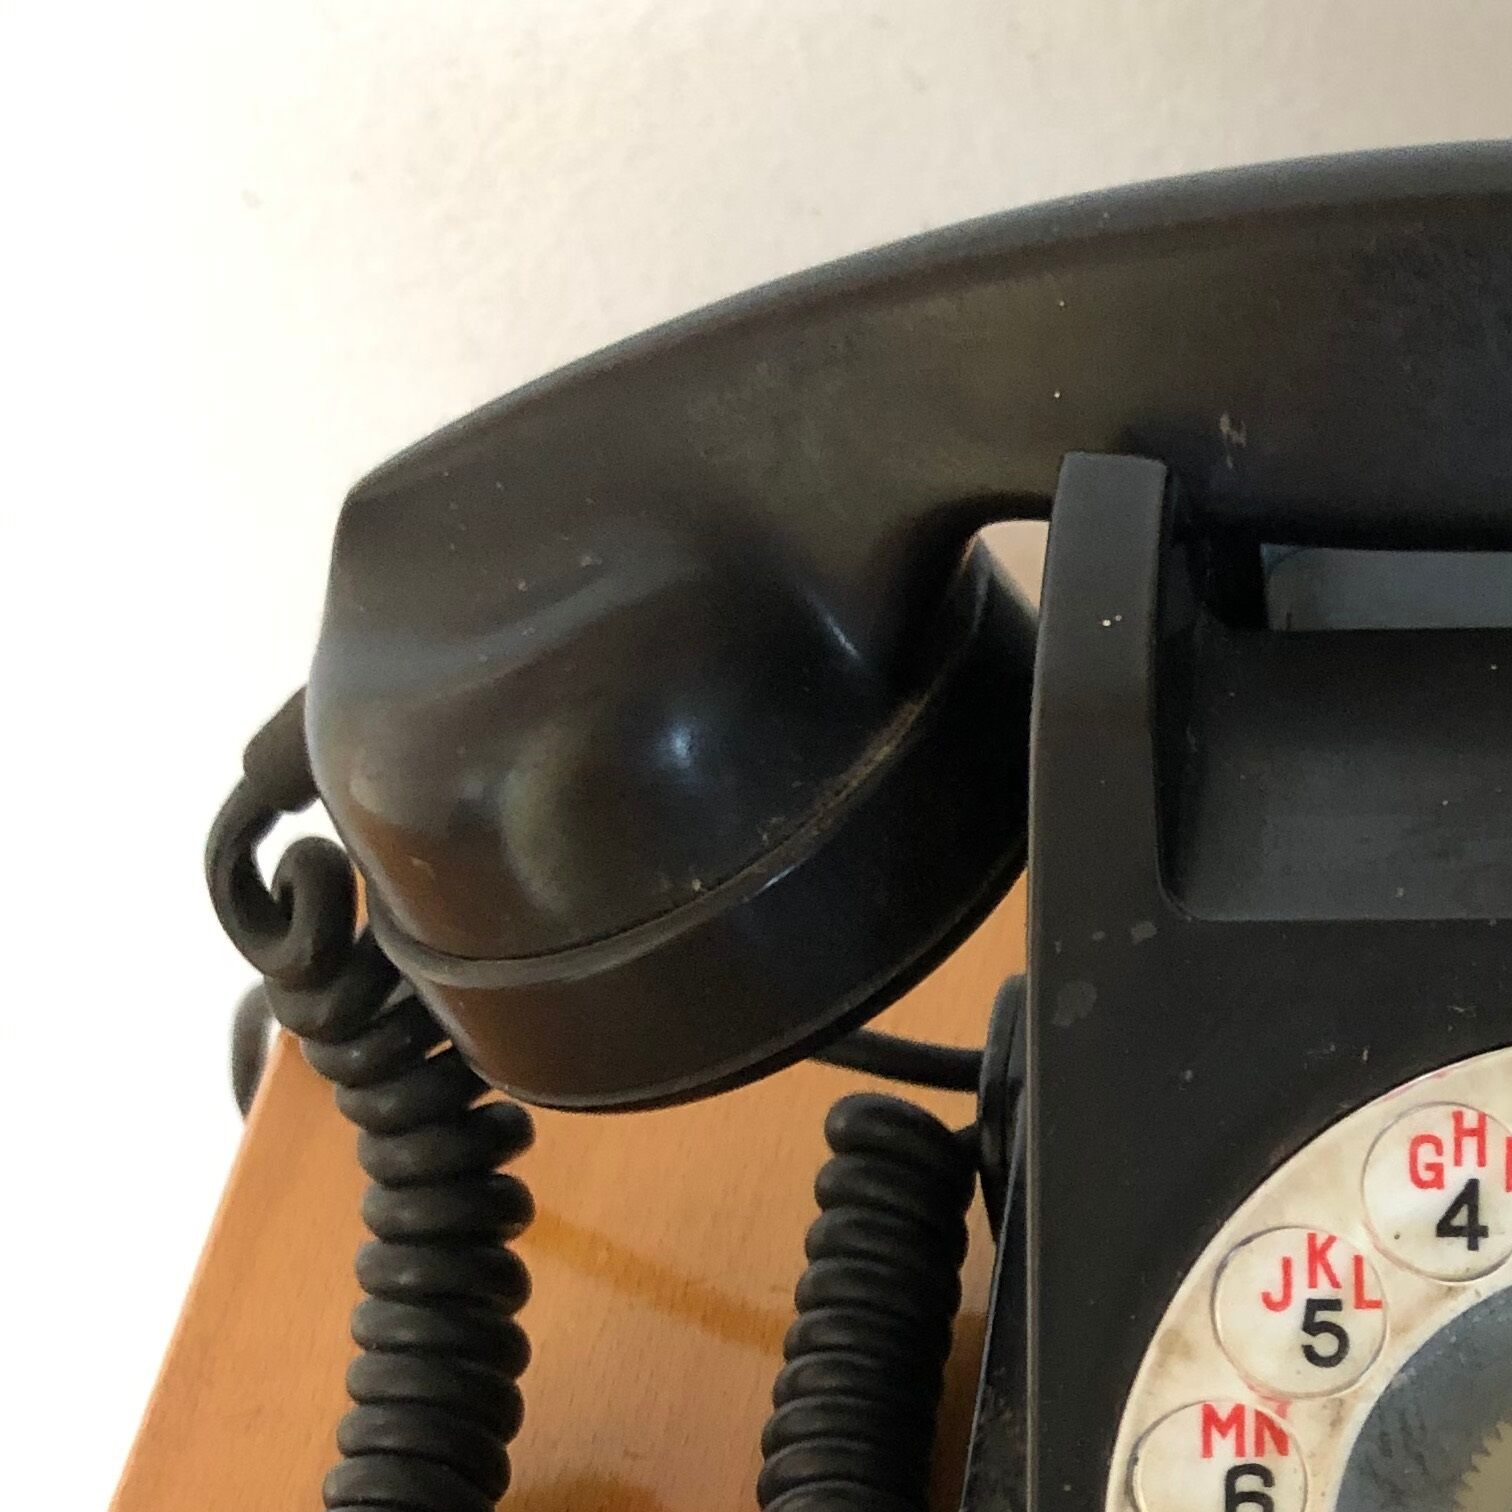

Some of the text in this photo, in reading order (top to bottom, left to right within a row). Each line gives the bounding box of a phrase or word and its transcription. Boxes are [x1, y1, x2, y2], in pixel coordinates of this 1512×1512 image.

[1436, 1177, 1489, 1252] 4
[1260, 1232, 1383, 1312] JKL
[1301, 1298, 1350, 1369] 5
[1201, 1402, 1289, 1459] MN
